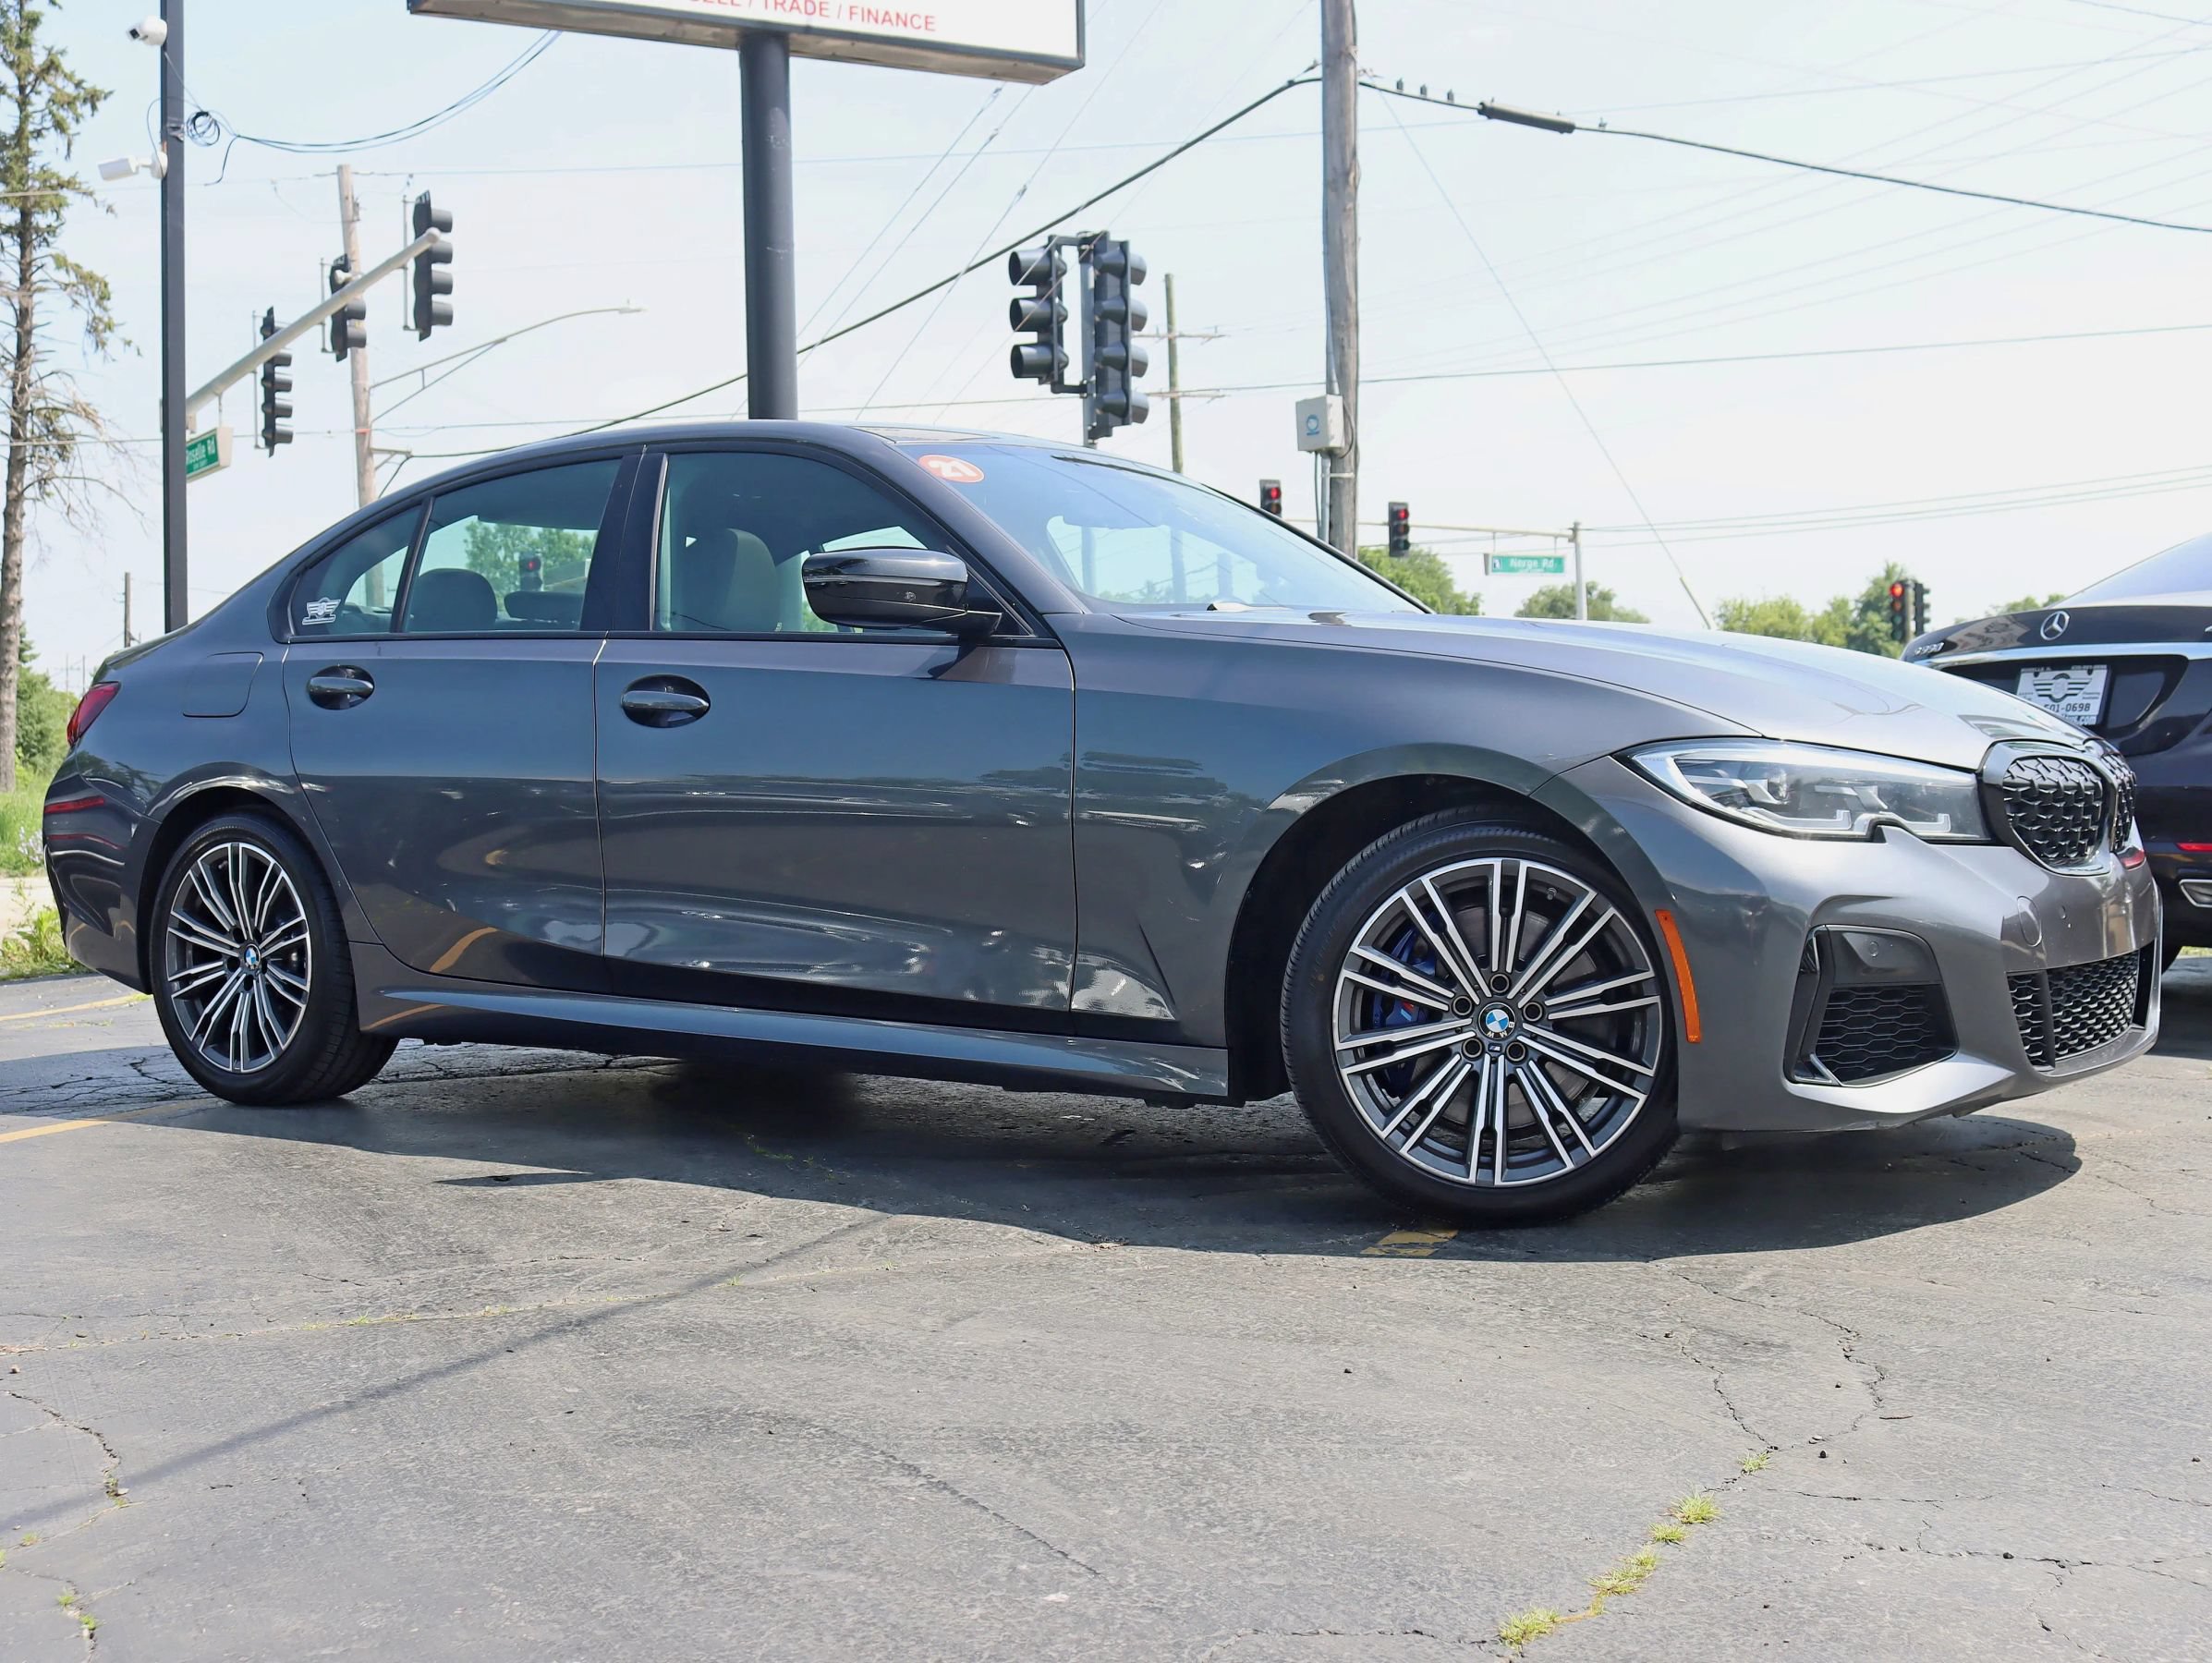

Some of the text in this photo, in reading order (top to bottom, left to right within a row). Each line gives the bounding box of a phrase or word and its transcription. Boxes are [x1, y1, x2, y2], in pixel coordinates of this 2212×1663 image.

[762, 0, 936, 30] TRADE / FINANCE
[207, 435, 215, 455] Rd
[928, 460, 978, 477] 21
[1509, 557, 1554, 569] Norge Rd
